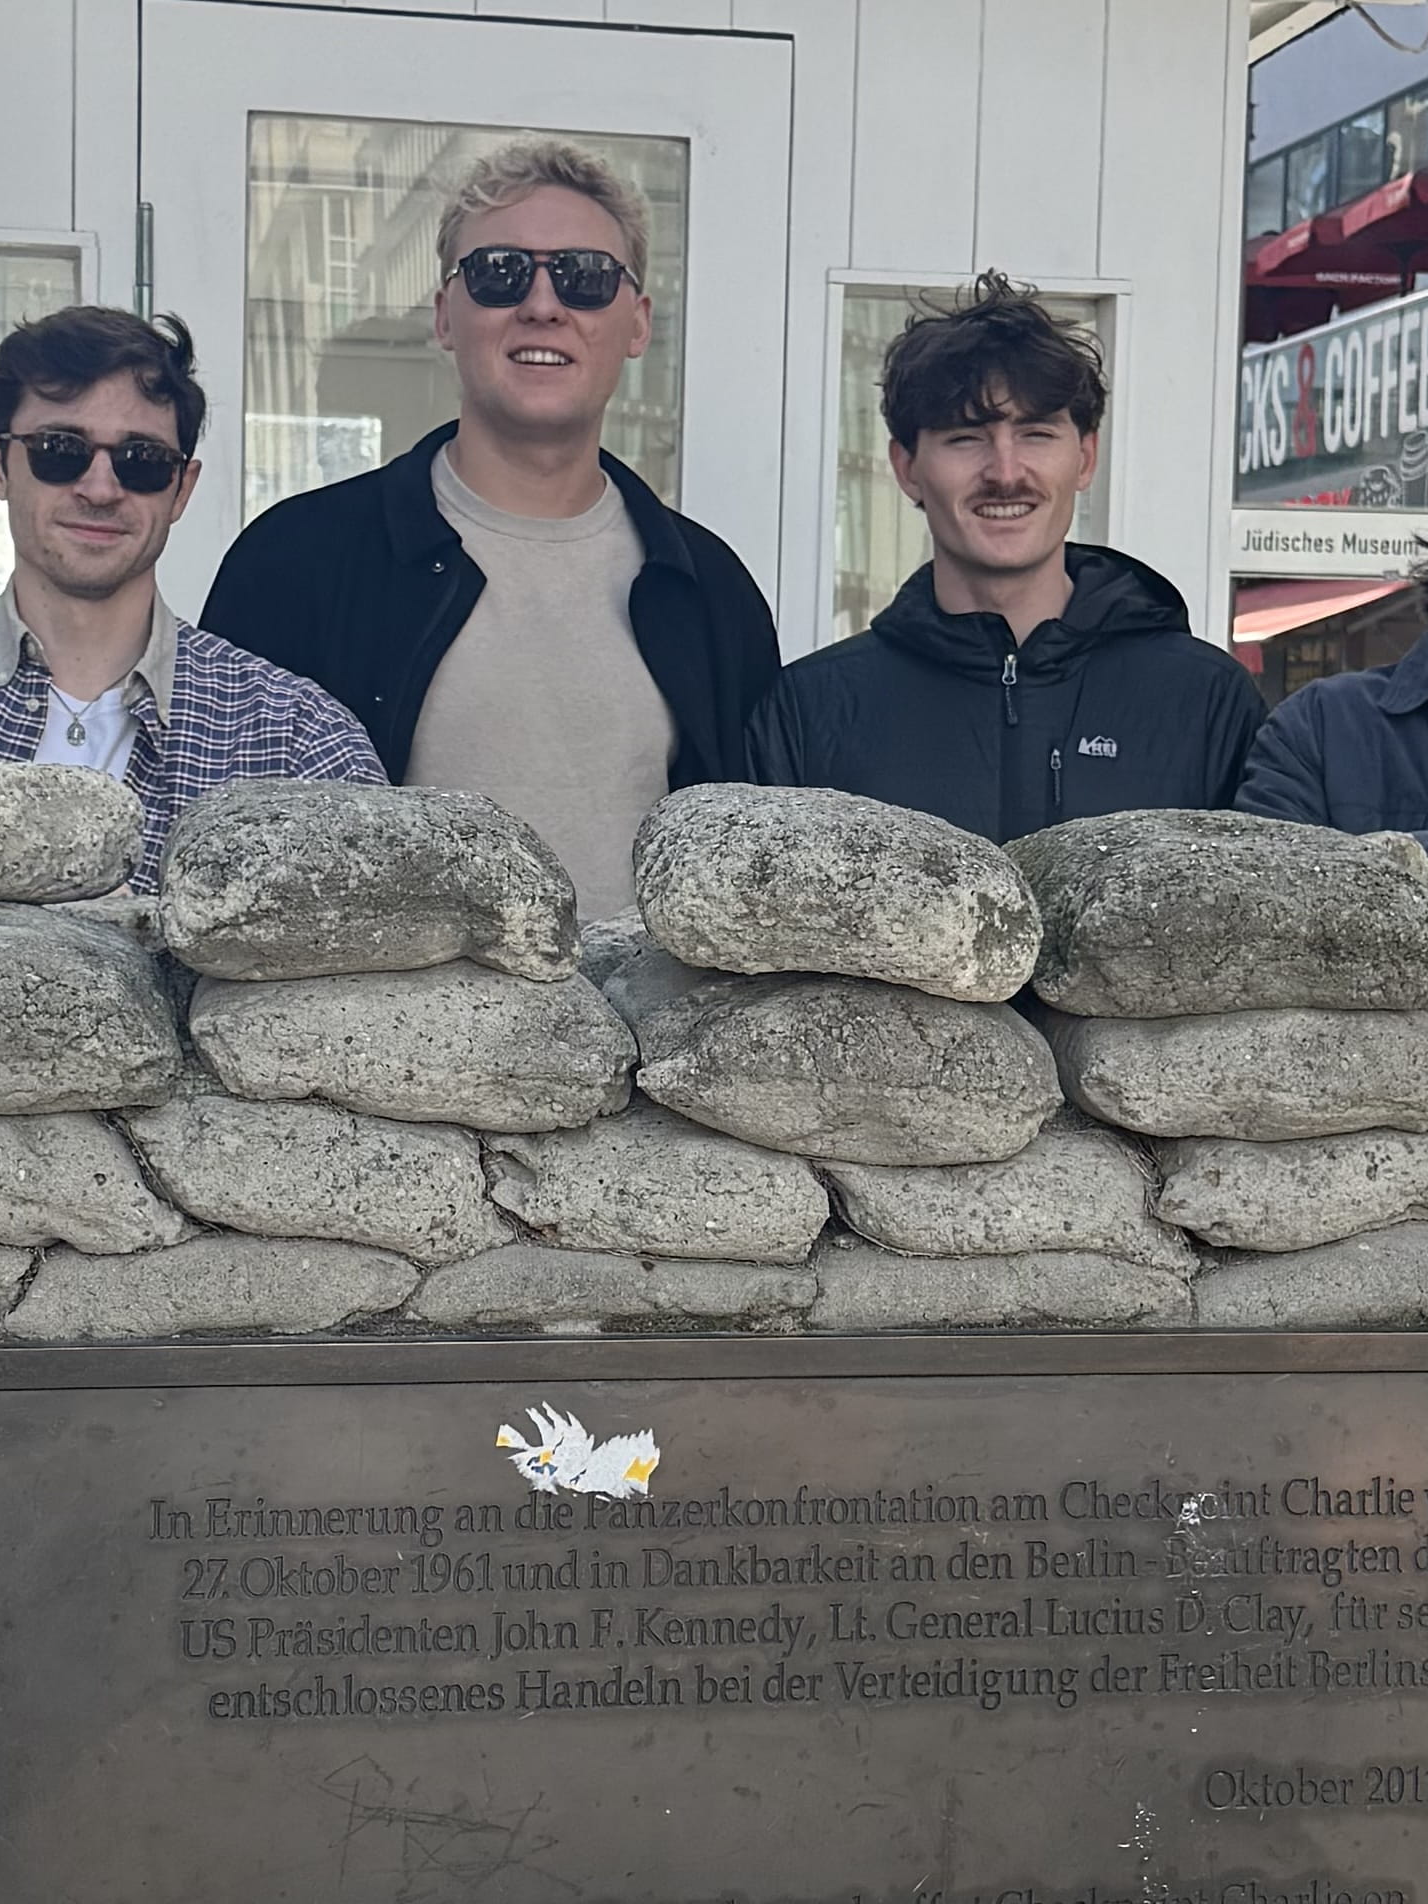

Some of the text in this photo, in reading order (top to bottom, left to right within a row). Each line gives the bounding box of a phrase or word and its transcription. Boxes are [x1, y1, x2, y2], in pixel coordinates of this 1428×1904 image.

[1292, 342, 1317, 459] &
[1241, 528, 1420, 557] Jüdisches Museum
[148, 1498, 194, 1541] In
[204, 1497, 445, 1548] Erinnerung
[453, 1503, 504, 1535] an
[515, 1490, 574, 1532] die
[583, 1486, 983, 1531] Panzerkonfrontation
[990, 1492, 1050, 1524] am
[1060, 1480, 1271, 1523] Checkpoint
[1281, 1476, 1415, 1518] Charlie
[182, 1558, 230, 1600] 27.
[238, 1555, 402, 1597] Oktober
[410, 1552, 492, 1594] 1961
[502, 1550, 580, 1593] und
[589, 1549, 631, 1589] in
[641, 1543, 880, 1590] Dankbarkeit
[890, 1552, 938, 1582] an
[946, 1541, 1016, 1583] den
[179, 1618, 238, 1660] US
[246, 1614, 481, 1660] Präsidenten
[488, 1609, 580, 1661] John
[590, 1607, 626, 1649] F.
[634, 1602, 818, 1658] Kennedy,
[829, 1602, 877, 1643] Lt.
[886, 1598, 1034, 1643] General
[1045, 1597, 1165, 1639] Lucius
[1176, 1595, 1214, 1637] D.
[1222, 1594, 1315, 1646] Clay,
[1328, 1592, 1388, 1637] für
[207, 1673, 507, 1720] entschlossenes
[515, 1665, 684, 1711] Handeln
[694, 1663, 753, 1705] bei
[763, 1662, 824, 1703] der
[833, 1656, 1080, 1711] Verteidigung
[1090, 1653, 1149, 1694] der
[1158, 1650, 1298, 1693] Freiheit
[1205, 1767, 1355, 1811] Oktober
